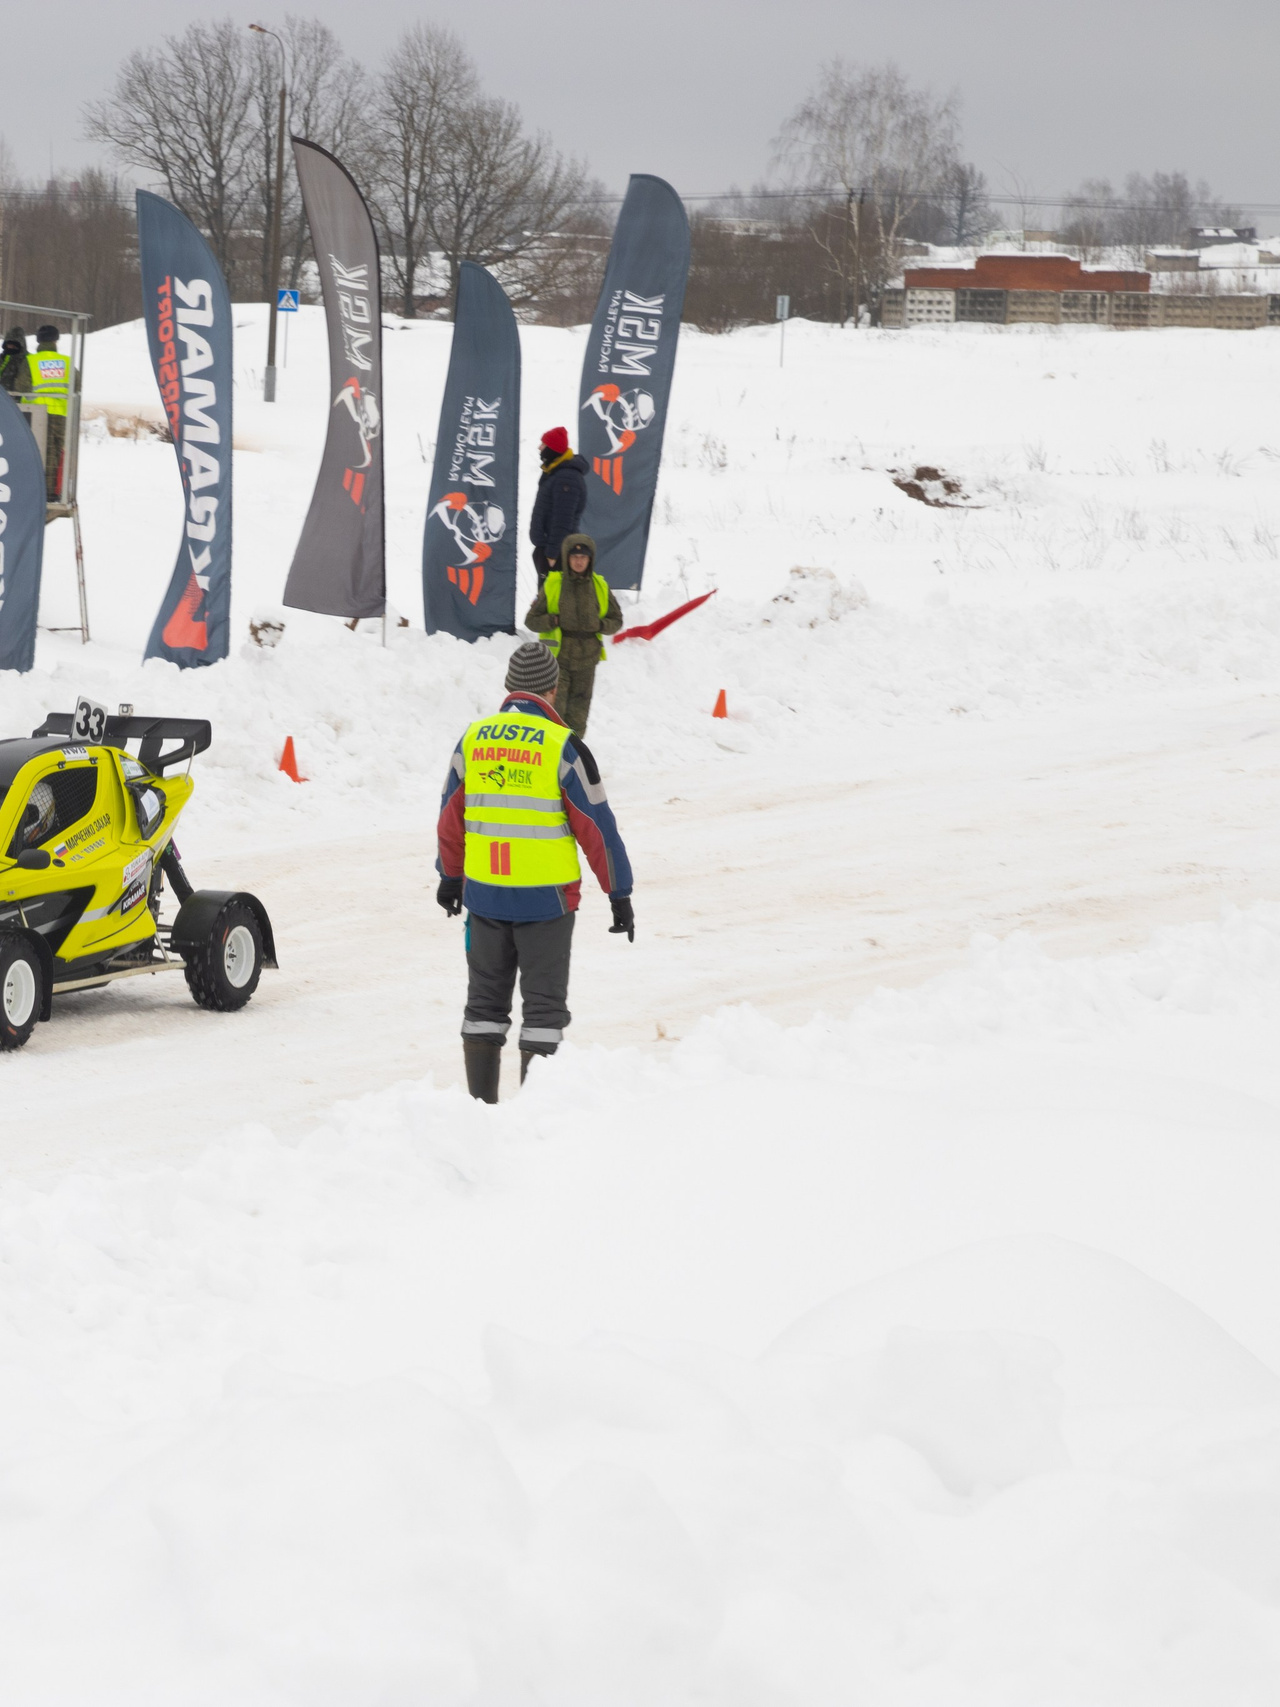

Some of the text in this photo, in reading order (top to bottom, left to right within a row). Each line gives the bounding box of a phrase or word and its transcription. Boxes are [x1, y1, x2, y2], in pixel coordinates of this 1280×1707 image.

[76, 701, 105, 742] 33
[475, 723, 545, 746] RUSTA
[471, 746, 542, 767] МАРШАЛ
[507, 768, 533, 785] MSK
[65, 813, 112, 851] МАРЧЕНКО ЗАХАР
[489, 841, 511, 876] 11
[122, 884, 146, 911] KRAMAR
